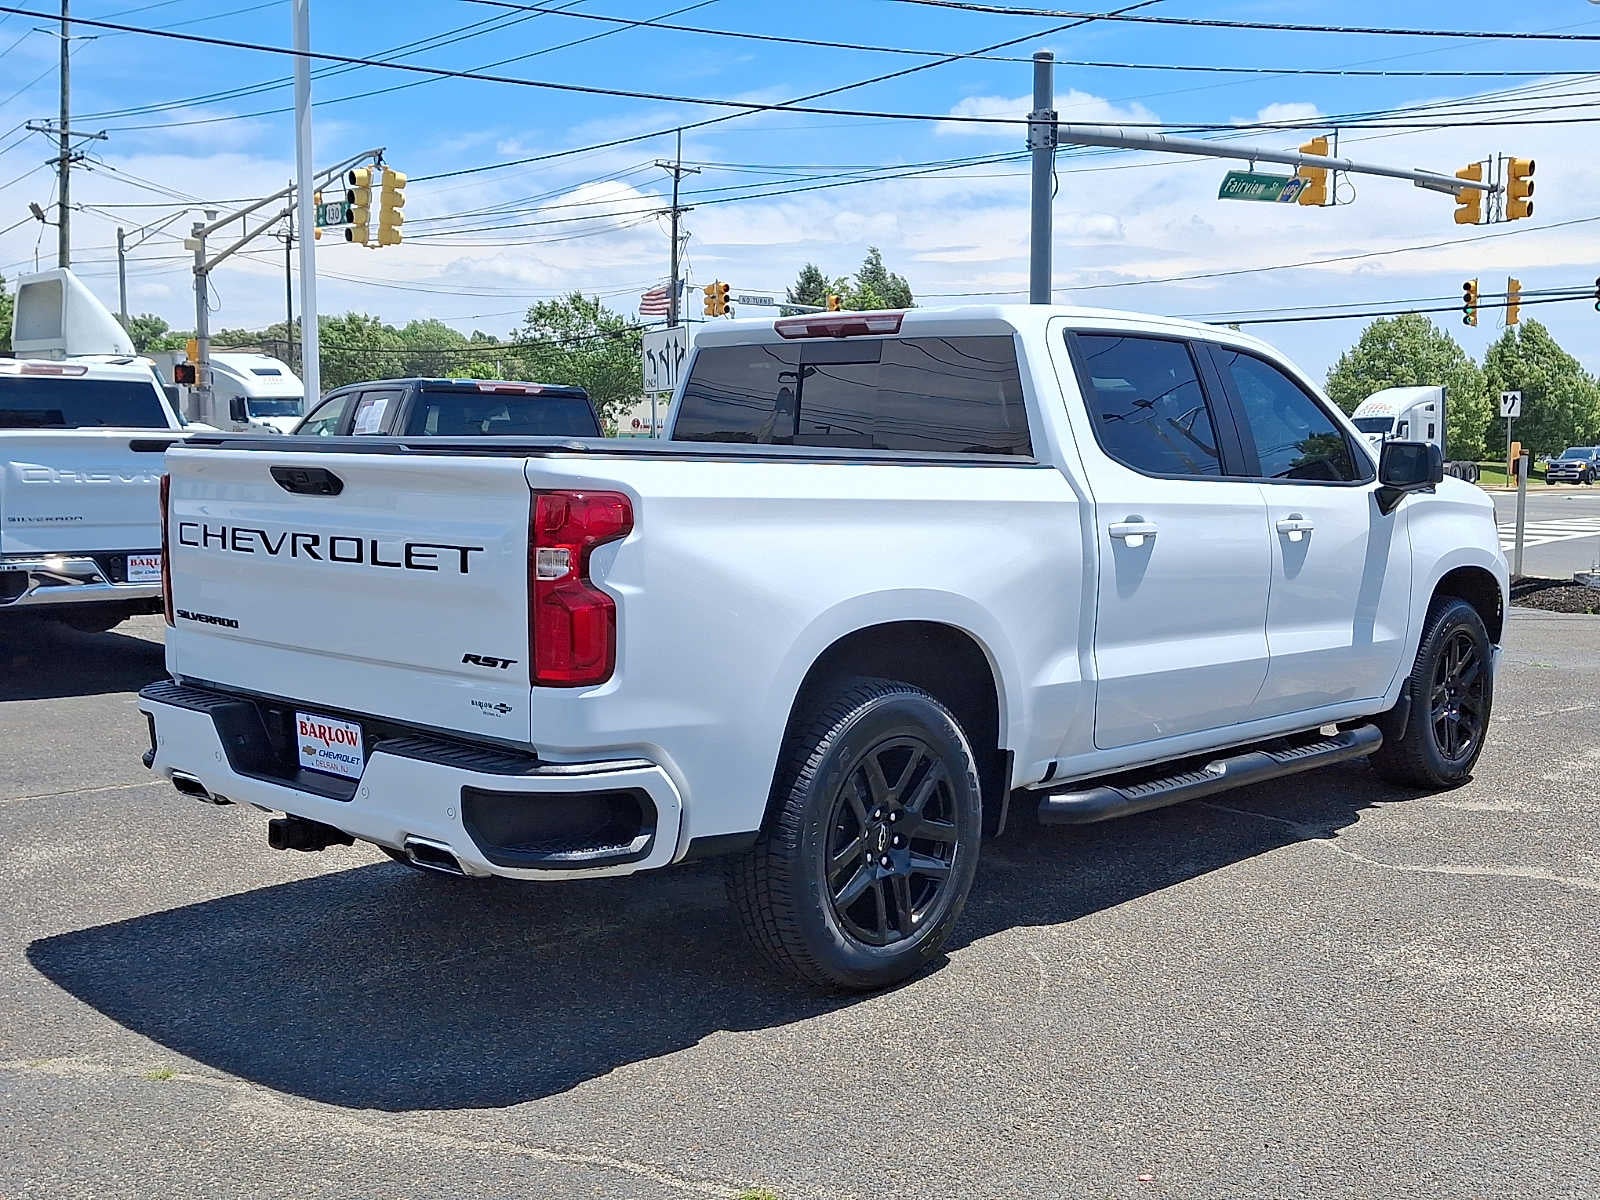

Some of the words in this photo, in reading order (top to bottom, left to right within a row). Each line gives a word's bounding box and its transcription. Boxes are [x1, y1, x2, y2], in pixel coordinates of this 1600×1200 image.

[1223, 177, 1266, 195] Fairview
[1269, 181, 1280, 192] St
[328, 207, 340, 220] 130
[645, 378, 657, 388] ONLY
[7, 515, 85, 523] SILVERADO
[178, 521, 484, 574] CHEVROLET
[176, 609, 239, 629] SILVERADO
[461, 653, 519, 670] RST
[299, 720, 358, 748] BARLOW
[318, 749, 361, 765] CHEVROLET
